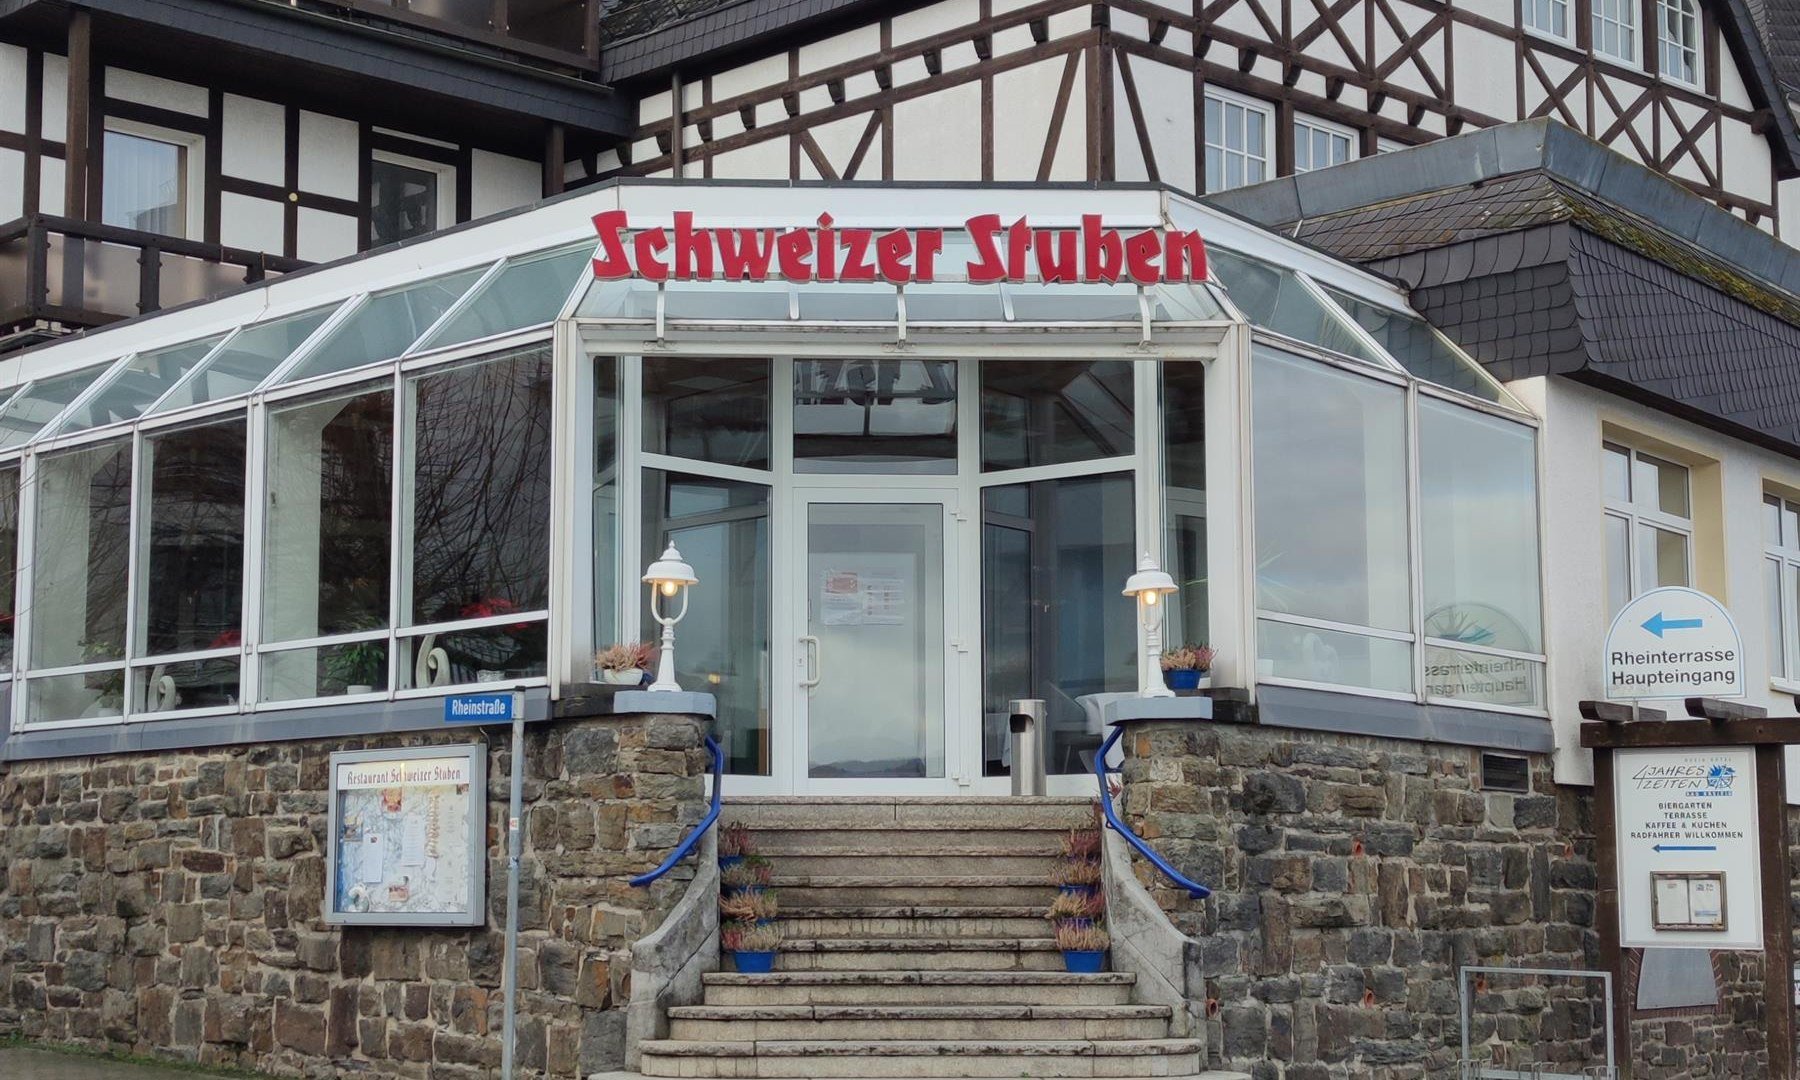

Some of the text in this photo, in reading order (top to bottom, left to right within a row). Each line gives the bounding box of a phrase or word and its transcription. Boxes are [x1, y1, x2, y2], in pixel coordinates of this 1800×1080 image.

[591, 209, 1208, 287] Schweizer Stuben
[1611, 650, 1735, 666] Rheinterrasse
[1612, 669, 1736, 686] Haupteingang
[451, 699, 506, 716] Rheinstraße
[347, 771, 389, 785] Restaurant
[434, 766, 461, 781] Stuben
[1648, 765, 1705, 777] JAHRES
[1642, 779, 1702, 790] ZEITEN
[1658, 802, 1712, 810] BIERGARTEN
